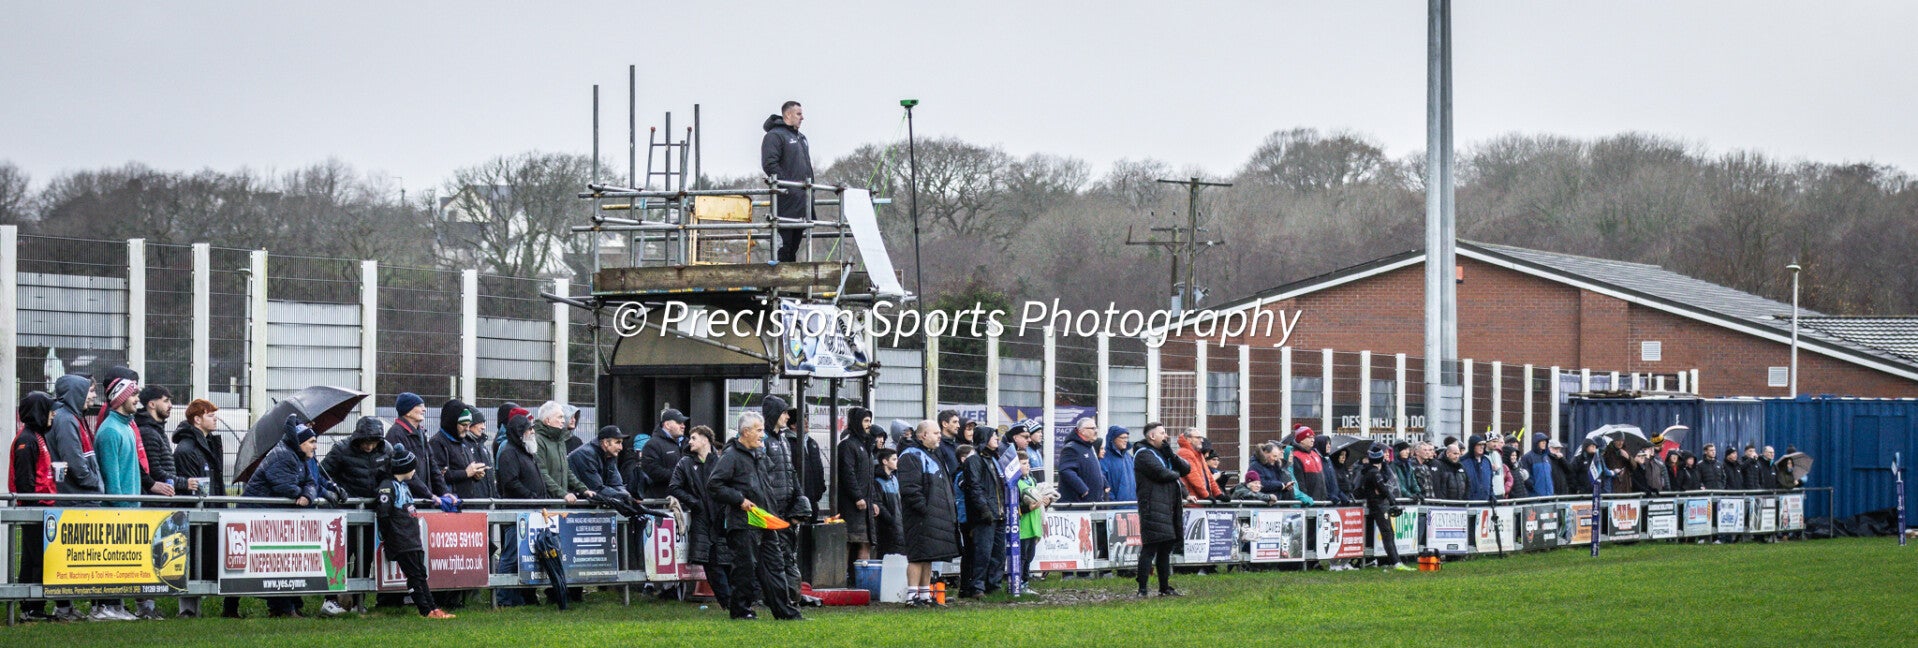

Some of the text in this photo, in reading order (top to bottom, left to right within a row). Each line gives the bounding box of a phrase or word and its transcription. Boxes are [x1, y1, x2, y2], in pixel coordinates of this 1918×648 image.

[61, 523, 151, 545] GRAVELLE PLANT LTD.
[249, 520, 294, 542] ANNIBYNIAETH
[300, 519, 322, 542] GYMRU
[435, 532, 483, 548] 01269 591103
[66, 549, 142, 562] Plant Hire Contractors
[657, 528, 673, 566] B
[249, 553, 322, 573] INDEPENDENCE FOR CYMRU
